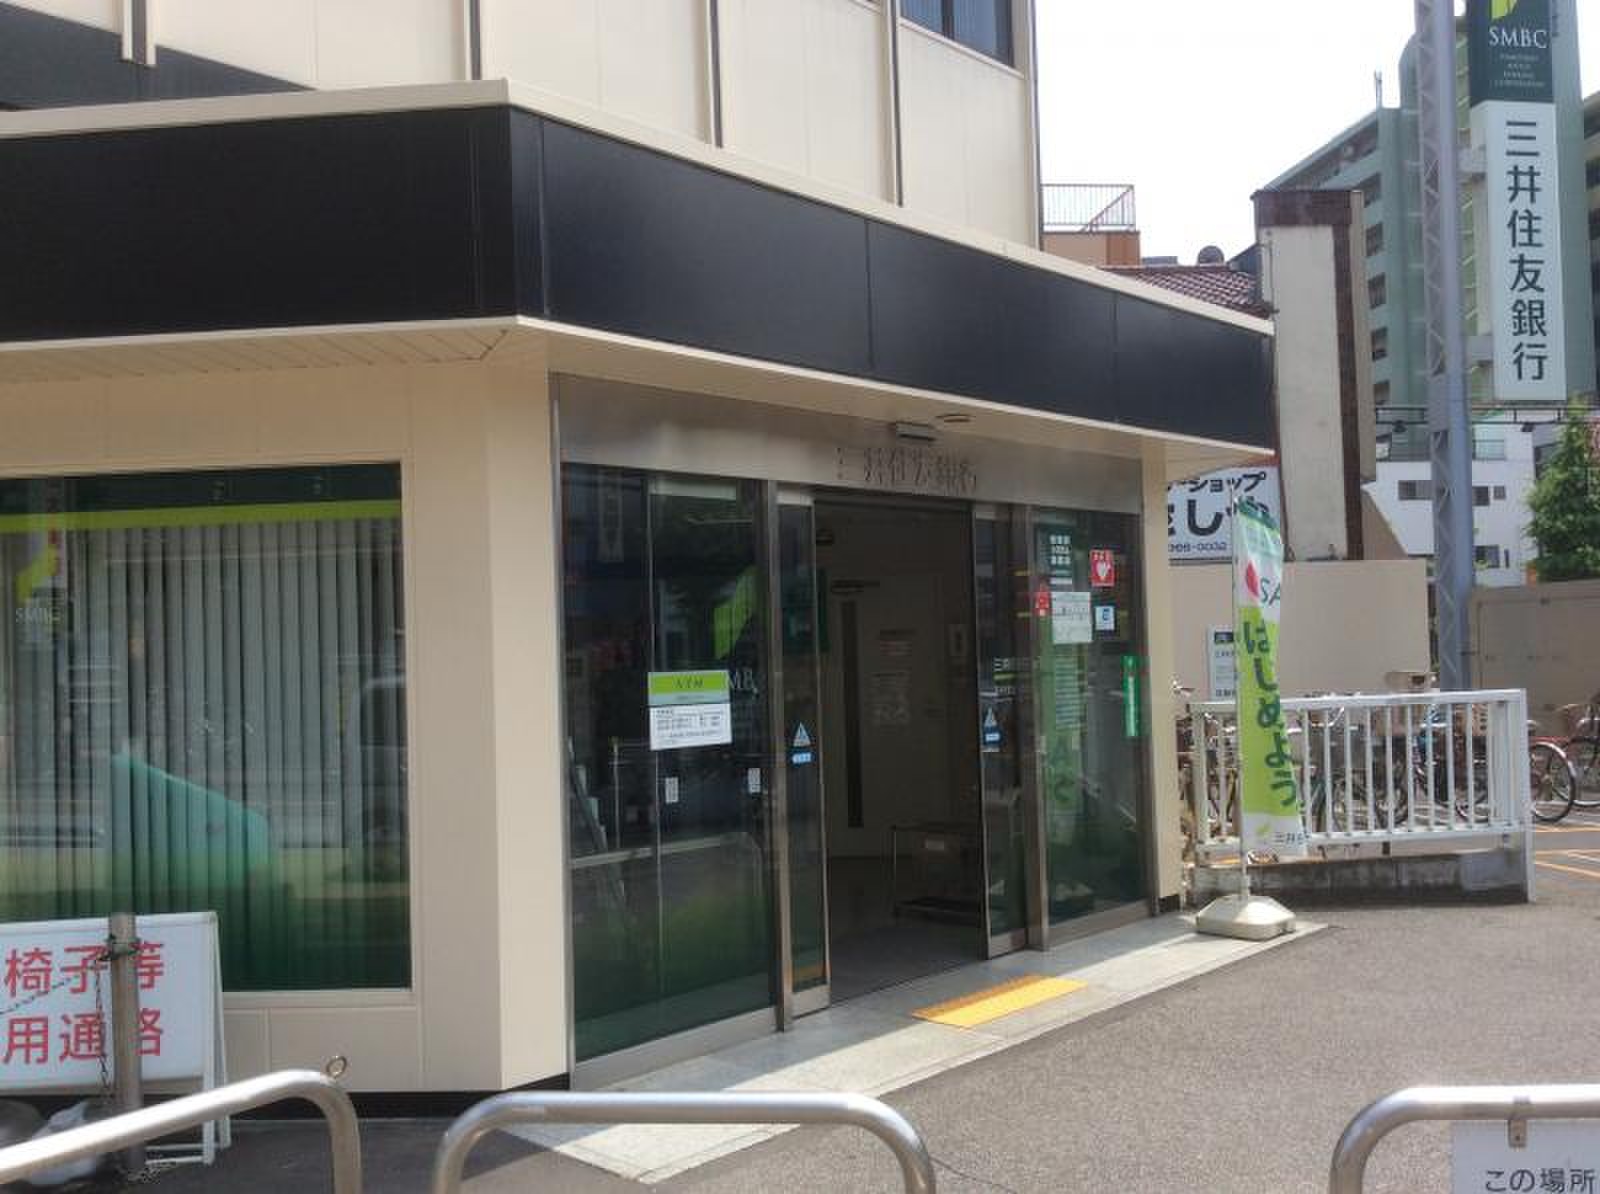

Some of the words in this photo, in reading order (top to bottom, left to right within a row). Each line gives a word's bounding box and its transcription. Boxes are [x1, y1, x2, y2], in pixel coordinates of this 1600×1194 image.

[1488, 26, 1547, 49] SMBC
[1505, 120, 1549, 382] 三井住友銀行
